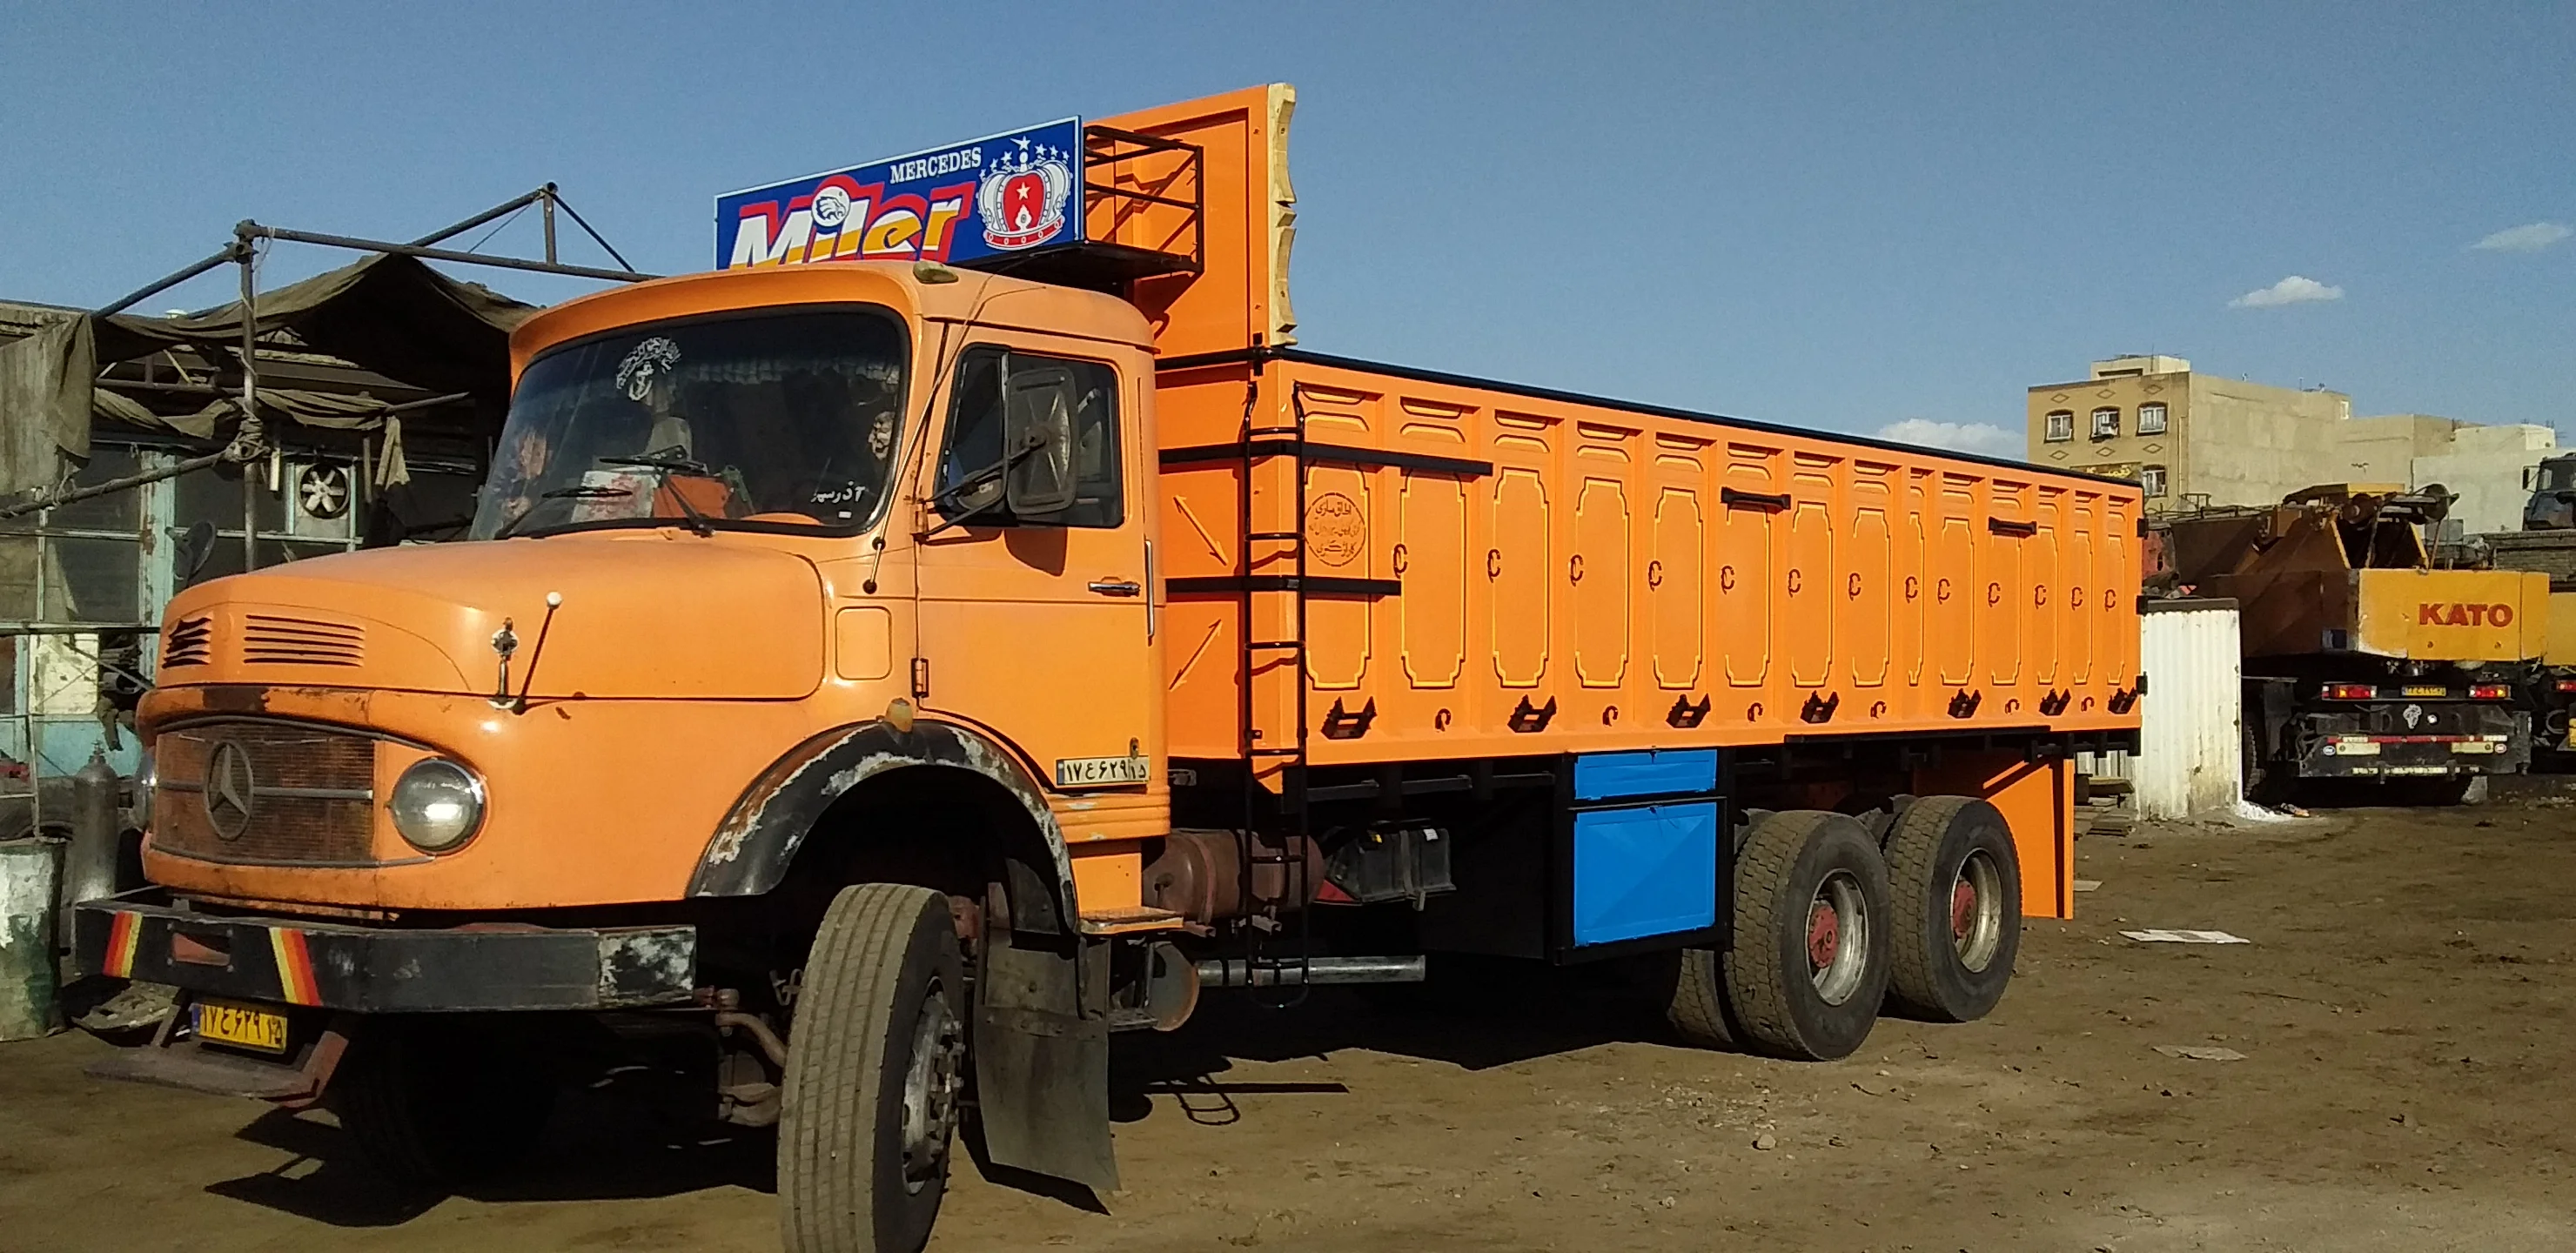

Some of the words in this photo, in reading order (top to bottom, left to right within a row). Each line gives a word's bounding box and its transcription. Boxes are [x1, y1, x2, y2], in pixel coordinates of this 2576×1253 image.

[889, 146, 983, 185] MERCEDES
[729, 181, 969, 269] Miler
[2419, 603, 2514, 627] KATO
